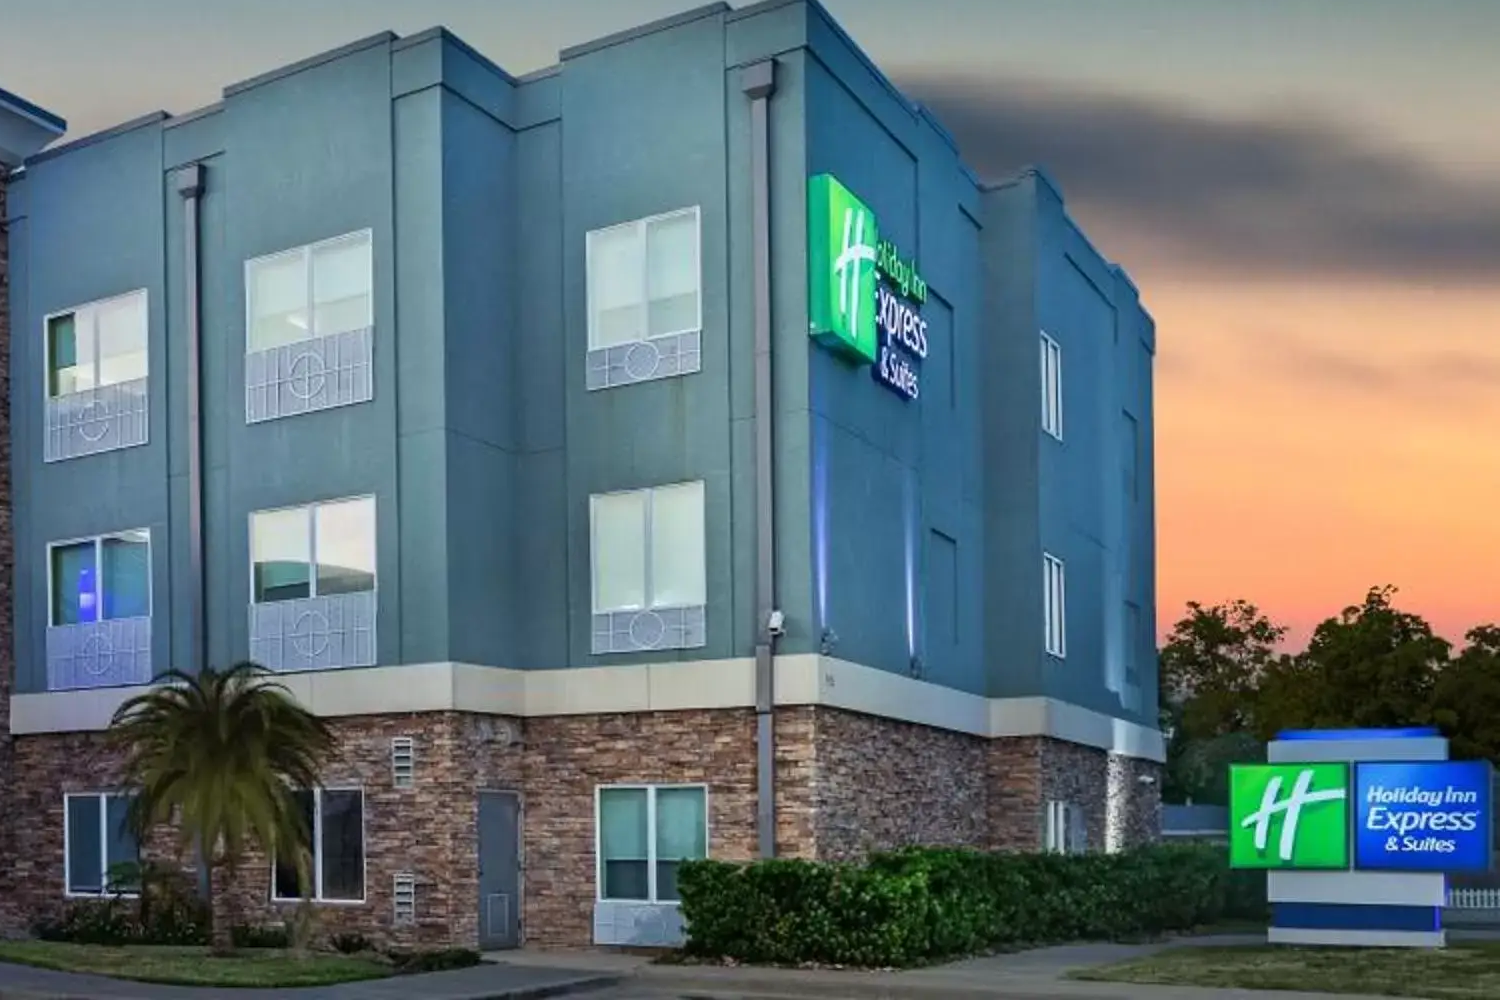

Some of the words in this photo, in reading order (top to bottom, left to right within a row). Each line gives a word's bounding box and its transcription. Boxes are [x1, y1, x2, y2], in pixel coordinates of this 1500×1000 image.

[911, 258, 928, 304] Inn
[881, 346, 889, 380] &
[889, 353, 920, 399] Suites
[1367, 785, 1443, 806] Holiday
[1445, 785, 1477, 803] Inn
[1367, 806, 1477, 835] Express
[1385, 836, 1399, 851] &
[1401, 836, 1456, 852] Suites
